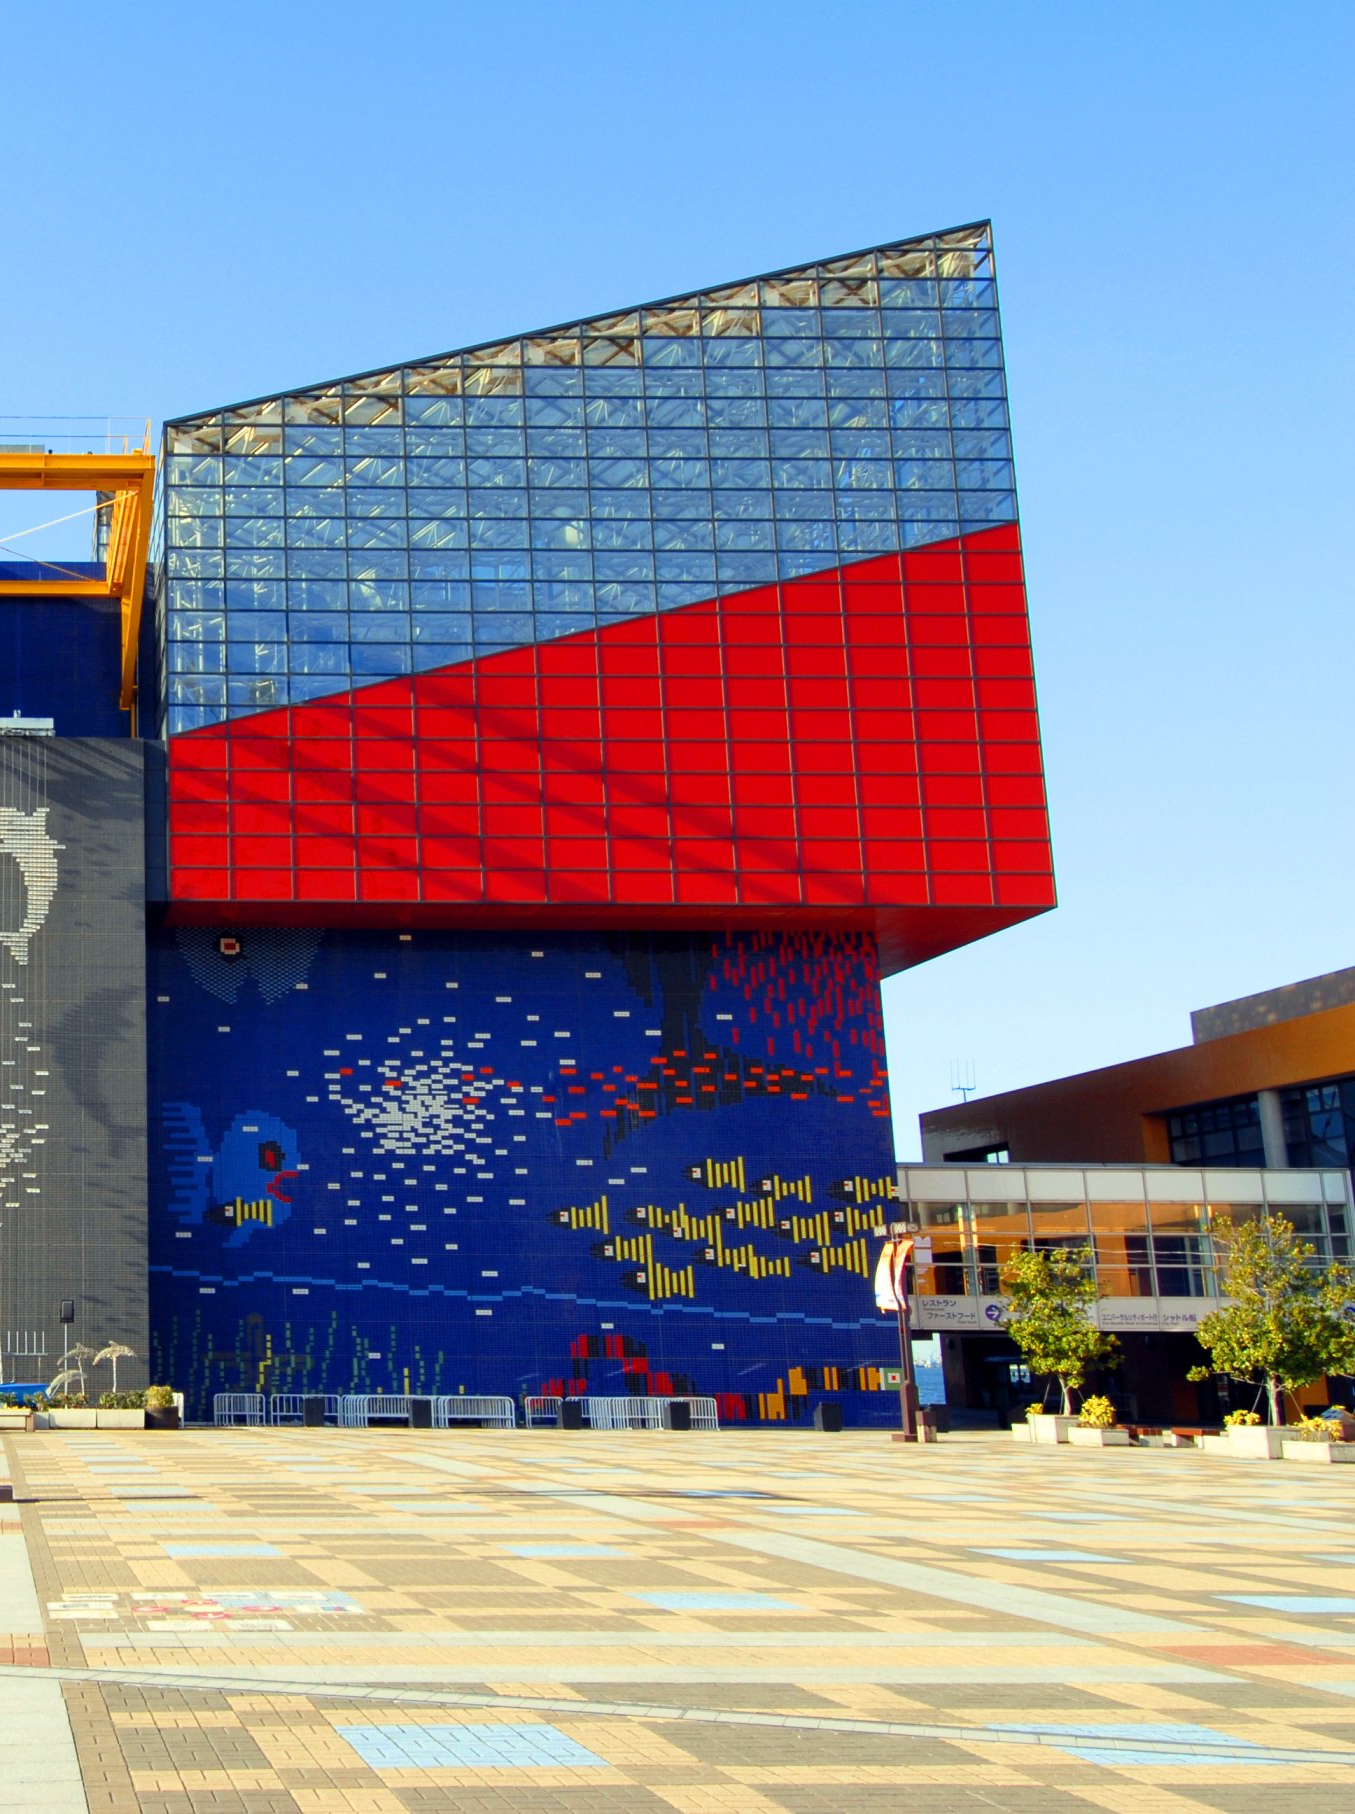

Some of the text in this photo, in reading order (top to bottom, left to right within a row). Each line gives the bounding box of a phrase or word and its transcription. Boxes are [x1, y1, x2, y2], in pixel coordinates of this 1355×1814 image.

[922, 1299, 956, 1307] レストラン
[927, 1312, 976, 1320] ファーストフード
